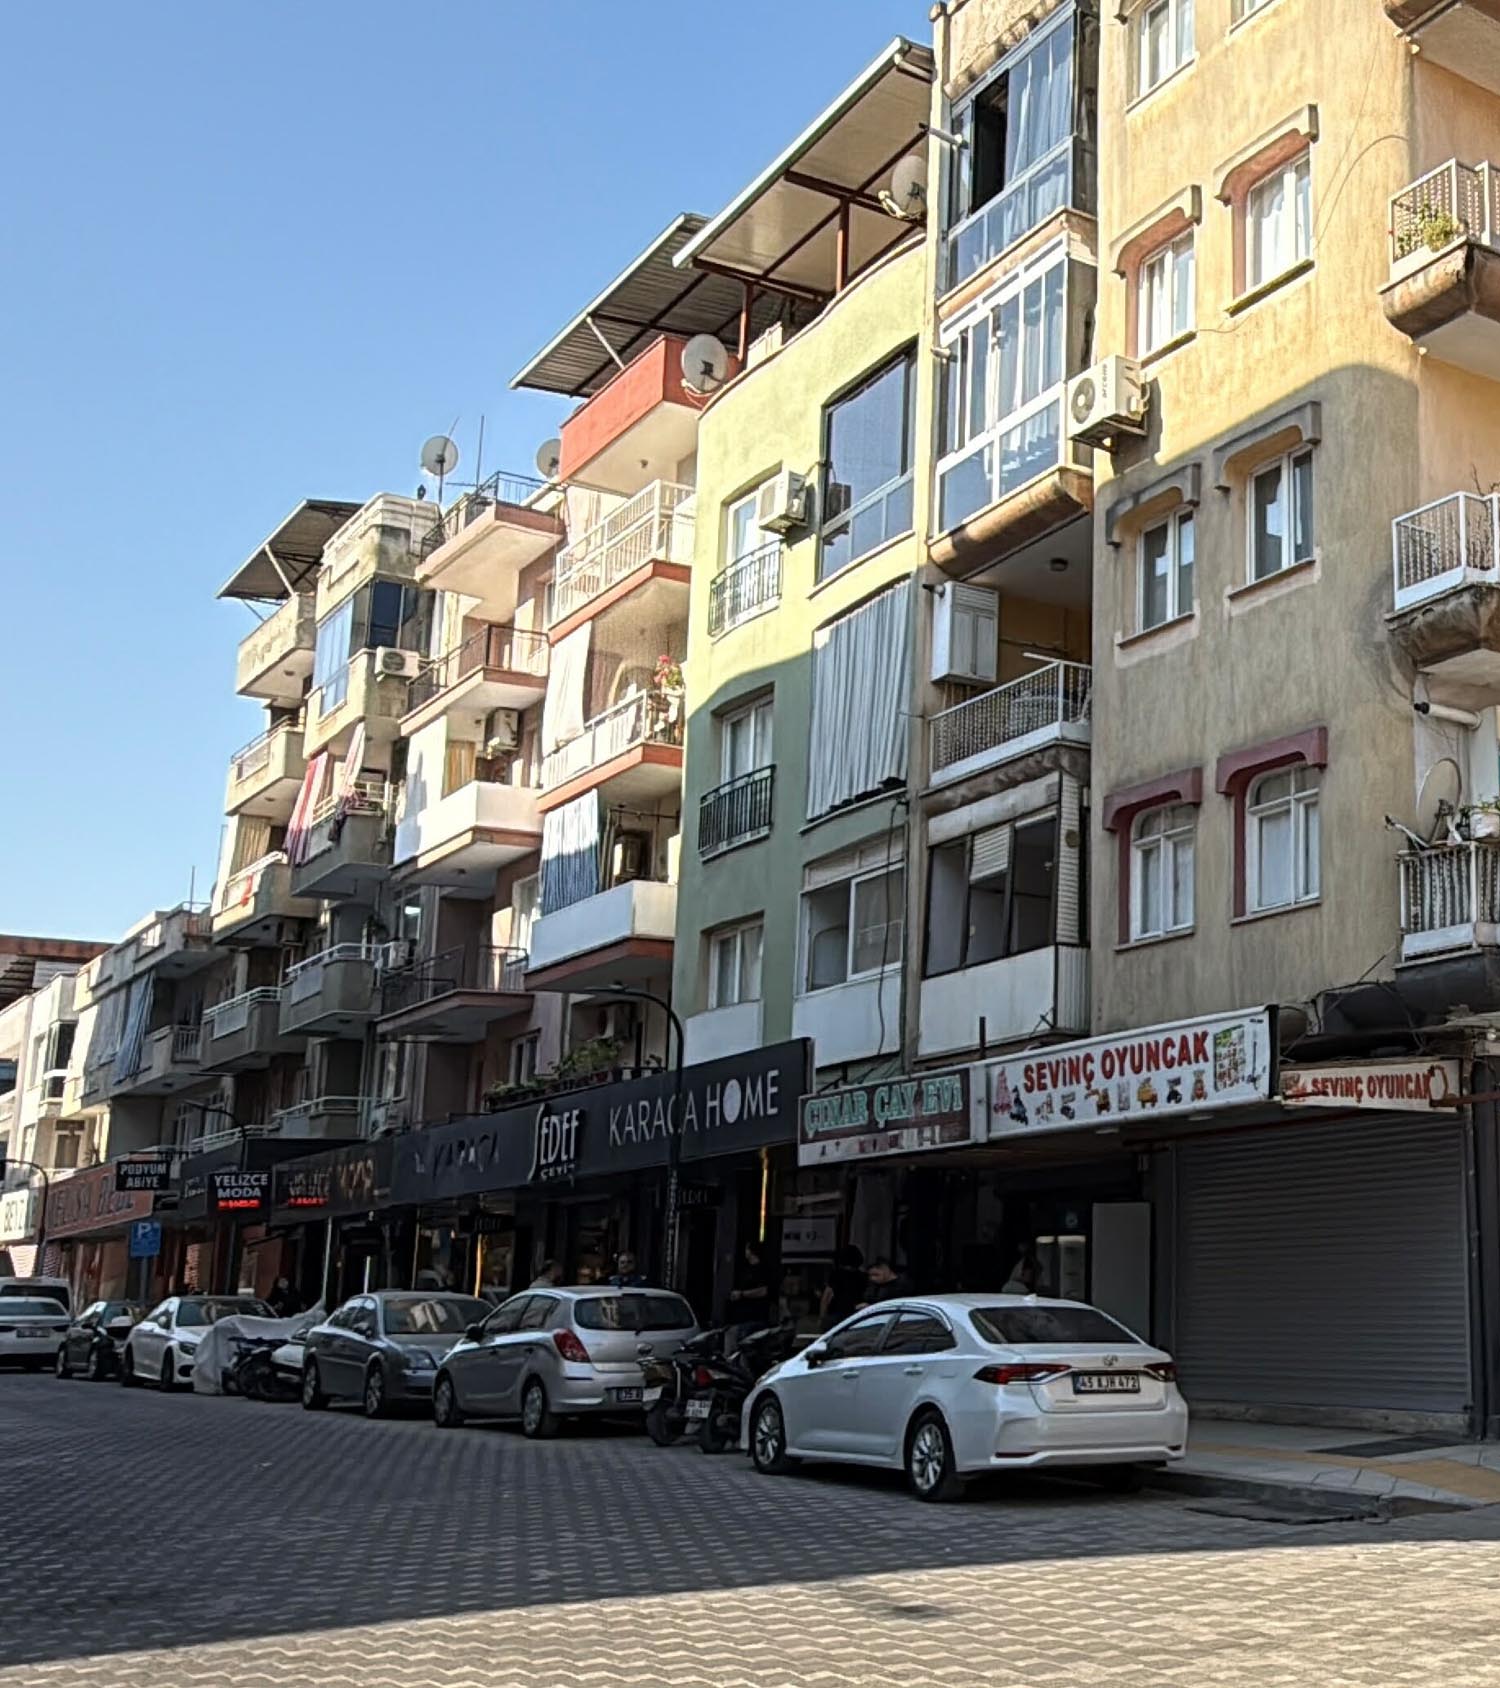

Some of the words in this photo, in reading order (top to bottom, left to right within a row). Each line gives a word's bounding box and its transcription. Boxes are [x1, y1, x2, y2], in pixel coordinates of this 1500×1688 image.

[1023, 1052, 1095, 1094] SEVİNÇ
[1101, 1029, 1210, 1080] OYUNCAK
[1311, 1076, 1364, 1103] SEVİNÇ
[1367, 1070, 1432, 1099] OYUNCAK
[609, 1089, 699, 1146] KARACA
[705, 1069, 780, 1129] HOME
[804, 1090, 869, 1139] ÇINAR
[873, 1080, 919, 1129] ÇAY
[526, 1102, 580, 1184] SEDEF
[120, 1162, 167, 1176] PODYUM
[214, 1173, 269, 1188] YELİZCE
[217, 1186, 262, 1199] MODA
[137, 1222, 152, 1240] P
